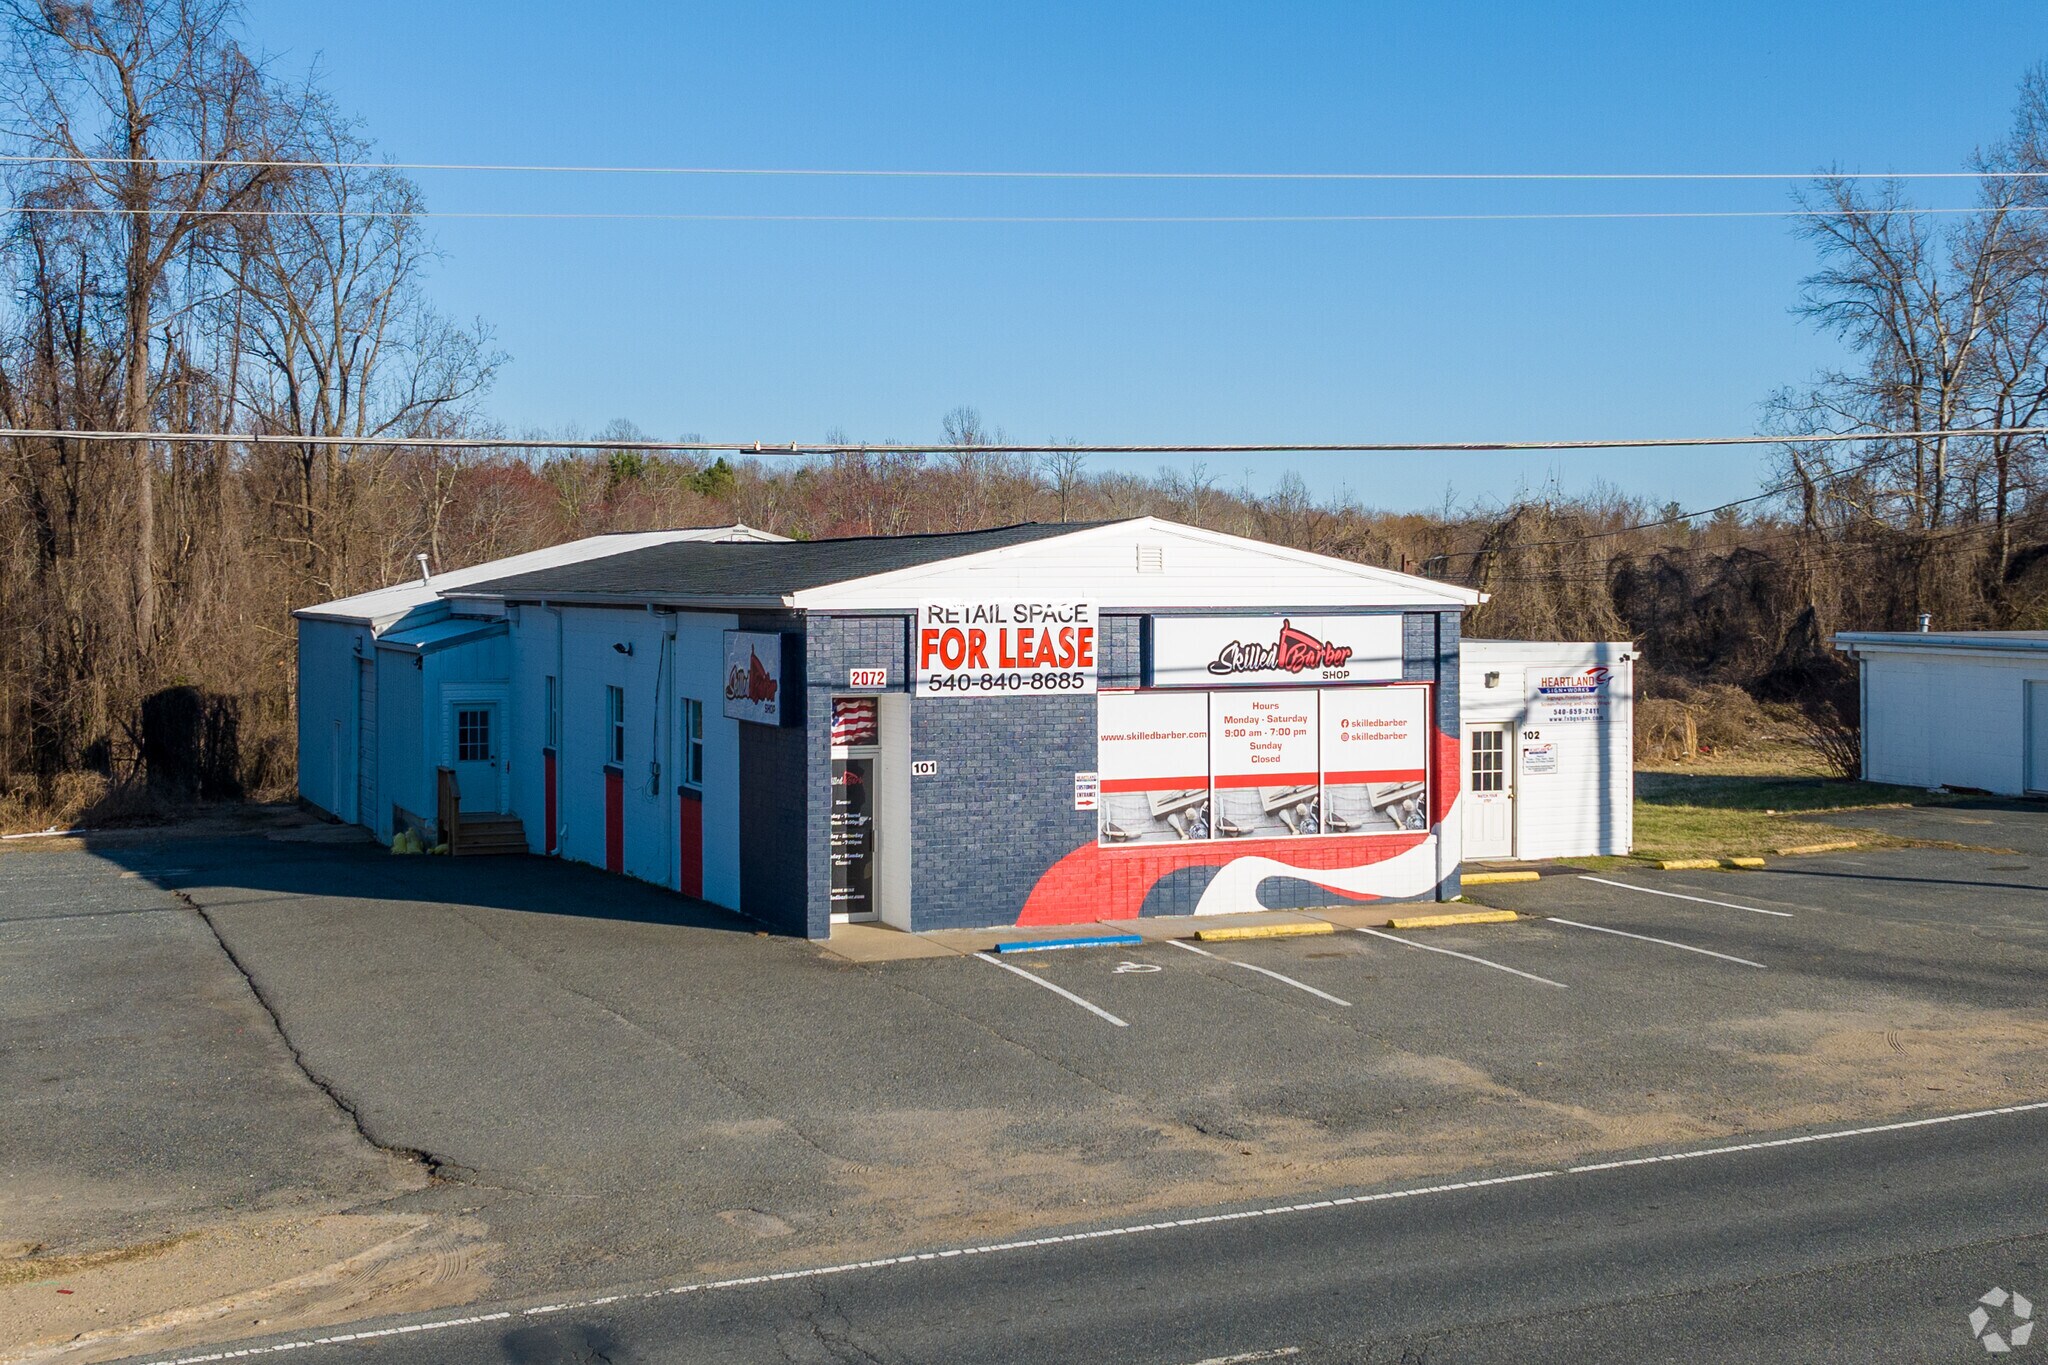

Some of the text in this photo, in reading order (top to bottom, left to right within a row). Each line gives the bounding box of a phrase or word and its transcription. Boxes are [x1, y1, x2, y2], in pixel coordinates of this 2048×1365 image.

[928, 603, 1088, 624] RETAIL SPACE
[921, 626, 1094, 671] FOR LEASE
[1207, 640, 1352, 675] Skilled Barber
[851, 671, 885, 686] 2072
[1322, 670, 1350, 680] SHOP
[928, 672, 1085, 691] 540-840-8685
[1541, 676, 1595, 687] HEARTLAND
[1252, 702, 1279, 710] Hours
[1224, 716, 1259, 725] Monday
[1267, 714, 1307, 724] Saturday
[1351, 718, 1408, 727] skilledbarber
[1100, 731, 1207, 741] www.skilledbarber.com
[1224, 728, 1246, 737] 9:00
[1270, 727, 1291, 736] 7:00
[1293, 729, 1306, 737] pm
[1351, 732, 1408, 741] skilledbarber
[1523, 730, 1540, 740] 102
[1249, 741, 1282, 751] Sunday
[1251, 754, 1281, 763] Closed
[913, 763, 936, 774] 101
